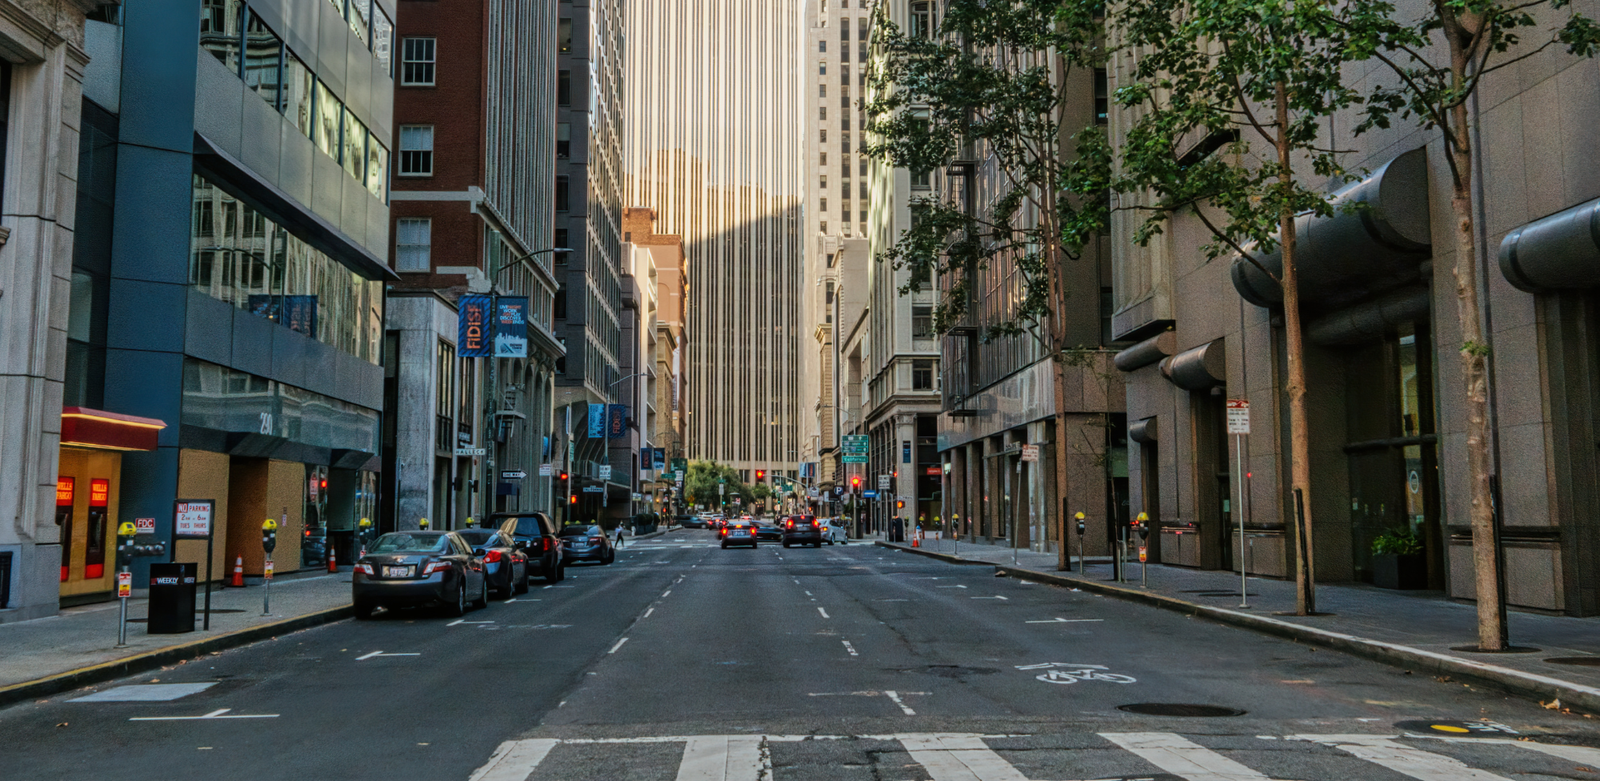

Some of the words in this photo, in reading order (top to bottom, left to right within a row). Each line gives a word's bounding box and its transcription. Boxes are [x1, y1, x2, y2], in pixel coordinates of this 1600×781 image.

[93, 484, 107, 492] WELLS
[92, 492, 107, 500] FARGO
[178, 503, 188, 512] NO
[137, 519, 154, 528] FDC
